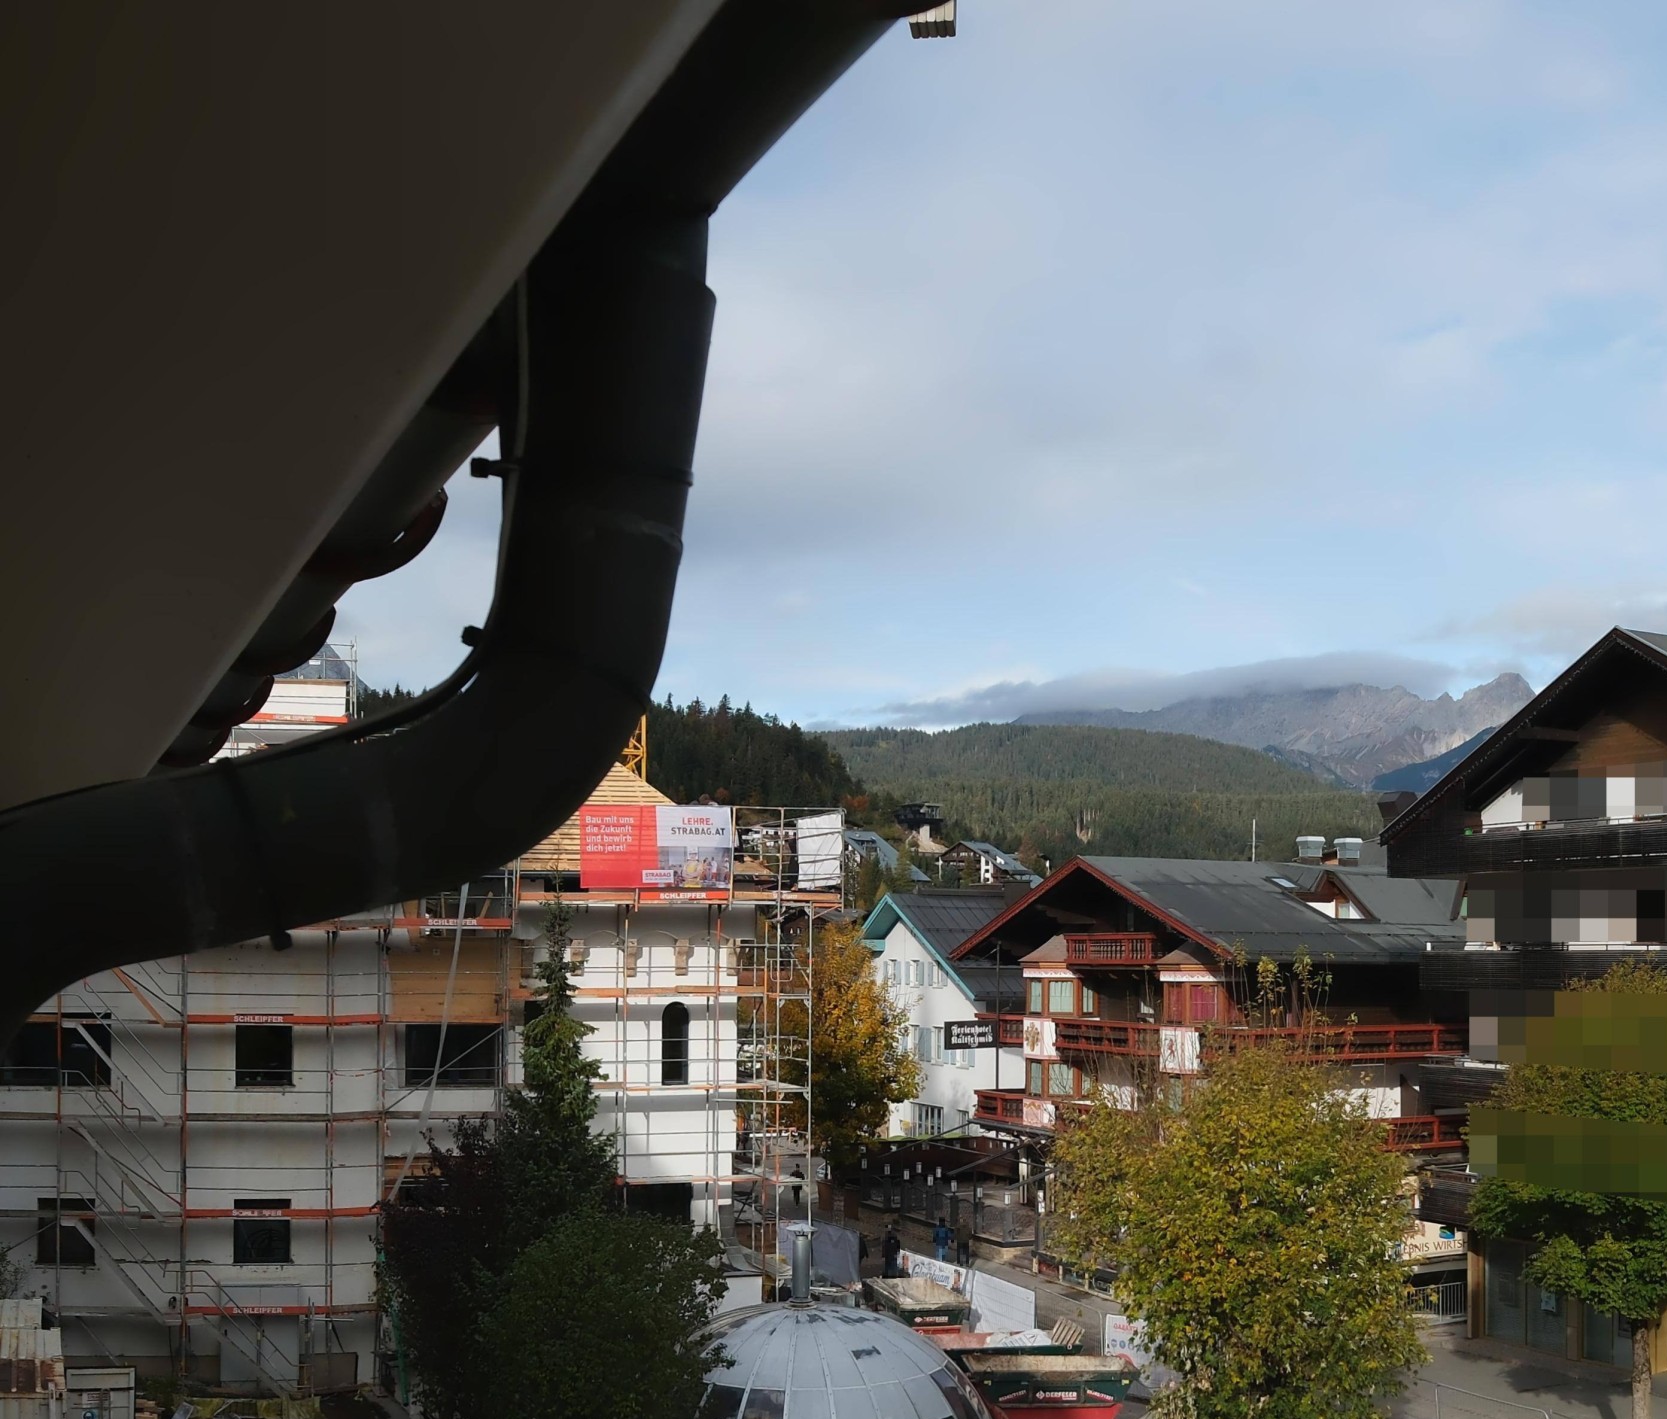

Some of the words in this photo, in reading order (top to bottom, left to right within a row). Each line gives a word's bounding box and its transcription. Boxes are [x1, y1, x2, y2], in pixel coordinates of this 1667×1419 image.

[585, 816, 601, 824] Bau
[603, 816, 617, 824] mit
[682, 818, 713, 826] LEHRE.
[585, 825, 599, 833] die
[601, 825, 632, 833] Zukunft
[671, 828, 726, 836] STRABAG.AT
[586, 835, 601, 843] und
[603, 835, 632, 843] bewirb
[586, 844, 603, 852] dich
[605, 844, 627, 854] jetzt!
[234, 1015, 284, 1023] SCHLEIPFER
